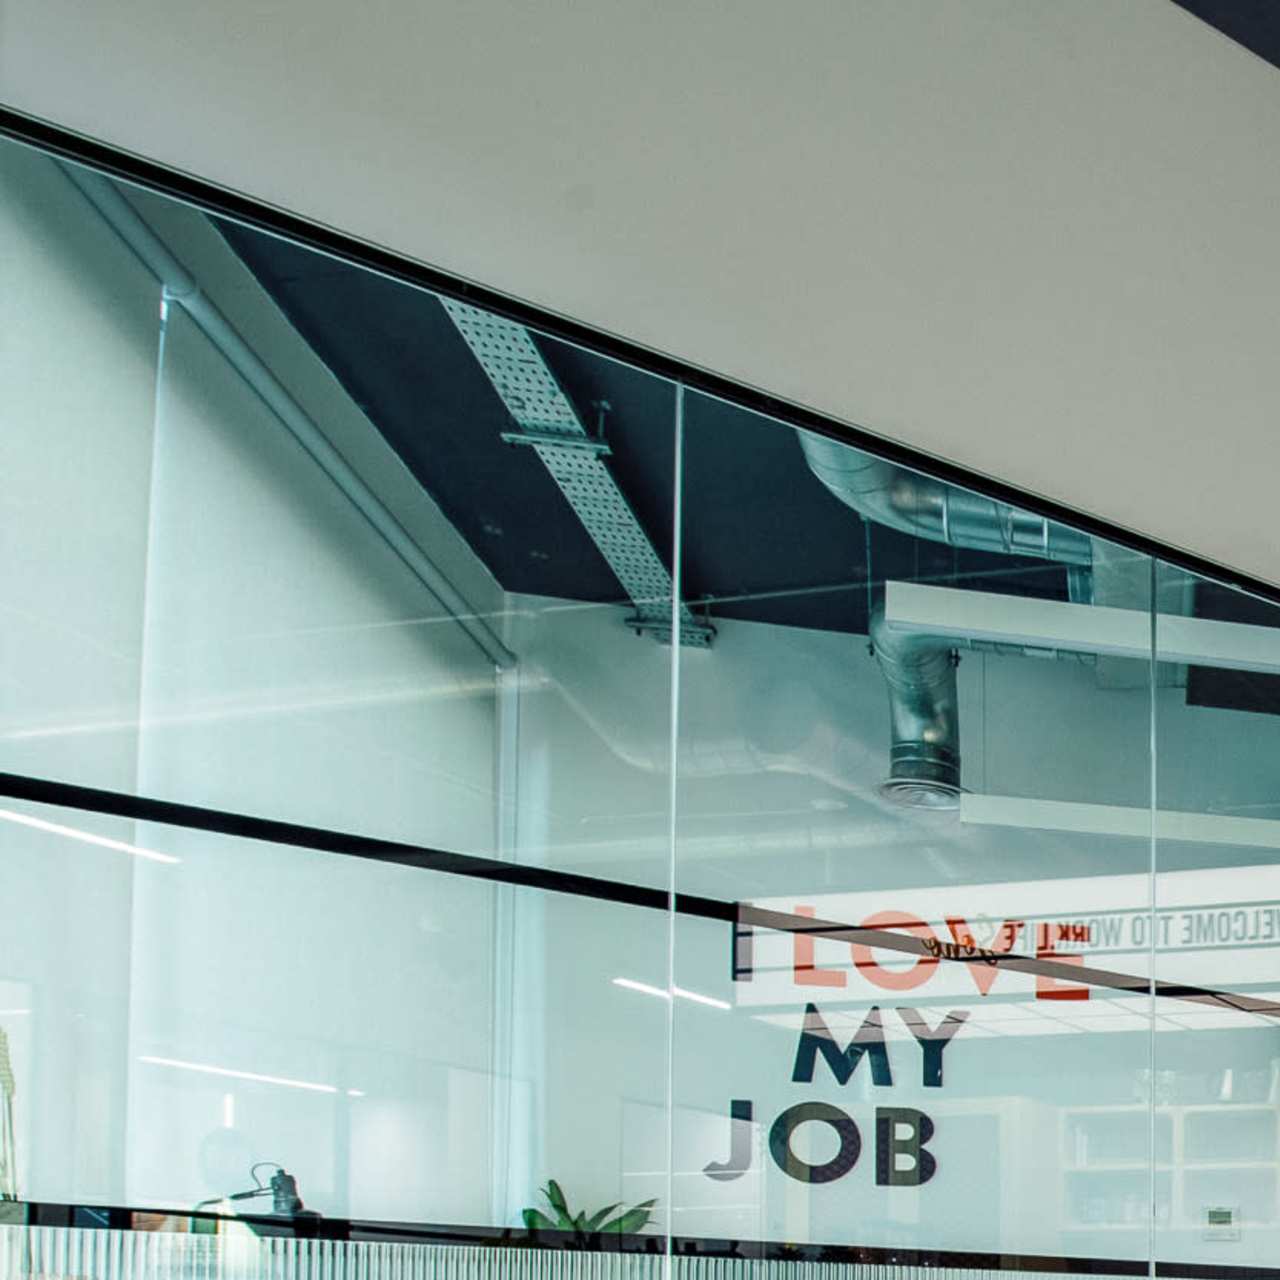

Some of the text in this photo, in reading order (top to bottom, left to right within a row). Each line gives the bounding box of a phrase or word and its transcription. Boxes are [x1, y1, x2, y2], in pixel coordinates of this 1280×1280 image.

[732, 901, 1090, 1001] I LOVE
[791, 1002, 972, 1088] MY
[701, 1099, 937, 1187] JOB
